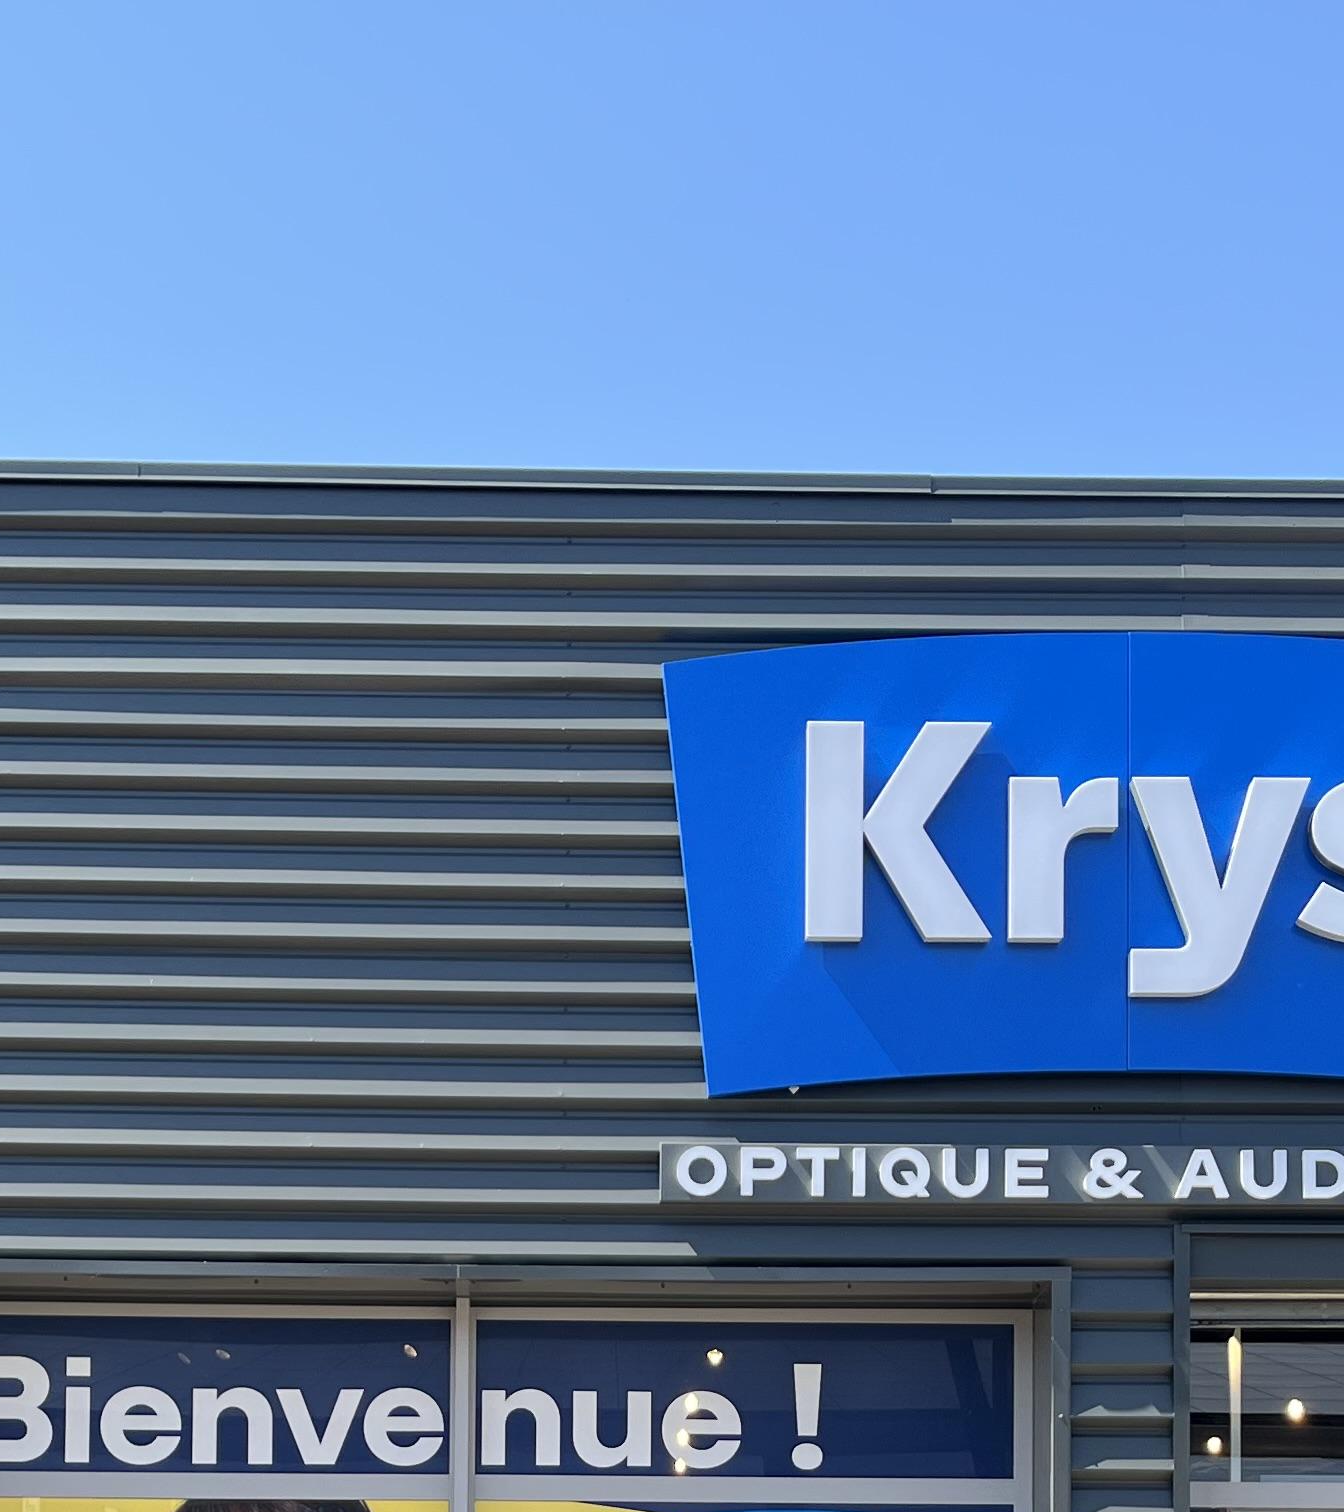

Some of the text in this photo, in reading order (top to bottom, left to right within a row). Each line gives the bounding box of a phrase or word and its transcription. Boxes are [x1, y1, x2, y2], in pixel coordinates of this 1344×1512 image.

[675, 1145, 1049, 1199] OPTIQUE
[1082, 1147, 1143, 1199] &
[792, 1363, 823, 1470] !
